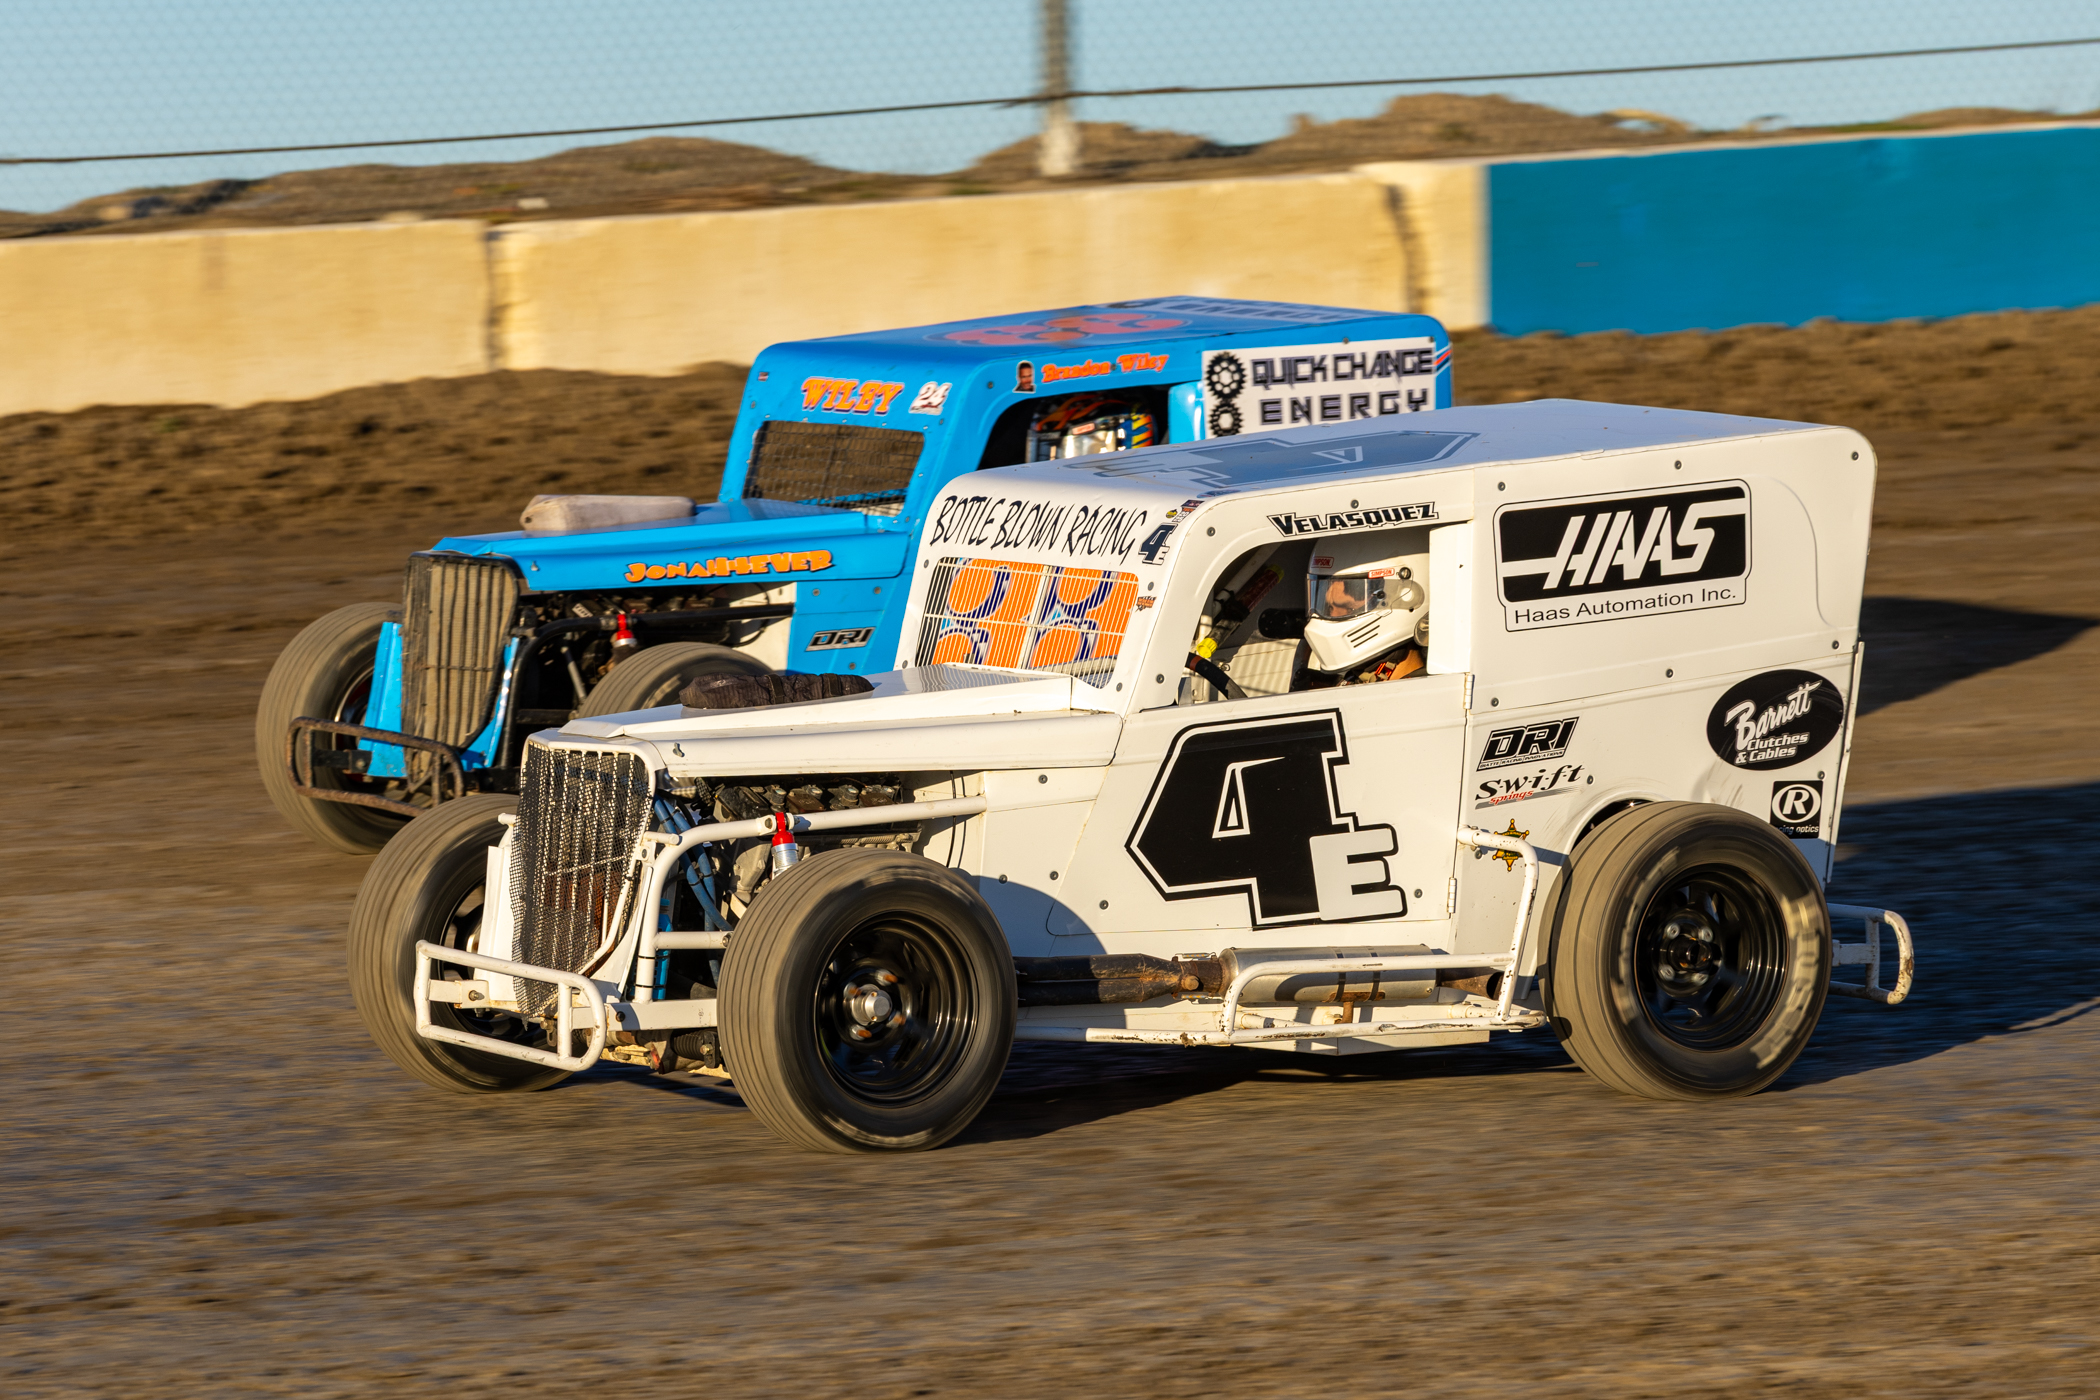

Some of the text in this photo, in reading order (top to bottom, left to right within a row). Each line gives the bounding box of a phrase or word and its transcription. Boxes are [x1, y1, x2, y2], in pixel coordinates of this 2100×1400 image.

[1041, 353, 1169, 383] Brandon Wiley
[1250, 347, 1435, 390] QUICK CHANGE
[802, 376, 904, 416] WILEY
[910, 381, 952, 408] 24
[1260, 388, 1429, 426] ENERGY
[930, 495, 1148, 566] BOTTLE BLOWN RACING
[1268, 502, 1438, 536] VELASQUEZ
[1138, 522, 1178, 565] 4E
[1530, 497, 1746, 591] HAAS
[1515, 588, 1736, 624] Haas Automation Inc.
[807, 627, 876, 649] DRI
[1724, 679, 1823, 751] Barnett
[1481, 718, 1577, 761] DRI
[1734, 745, 1797, 766] & Cables
[1747, 732, 1810, 751] Clutches
[1489, 790, 1534, 806] springs
[1782, 789, 1810, 815] R
[1124, 708, 1408, 931] 4E
[1795, 824, 1820, 835] optics
